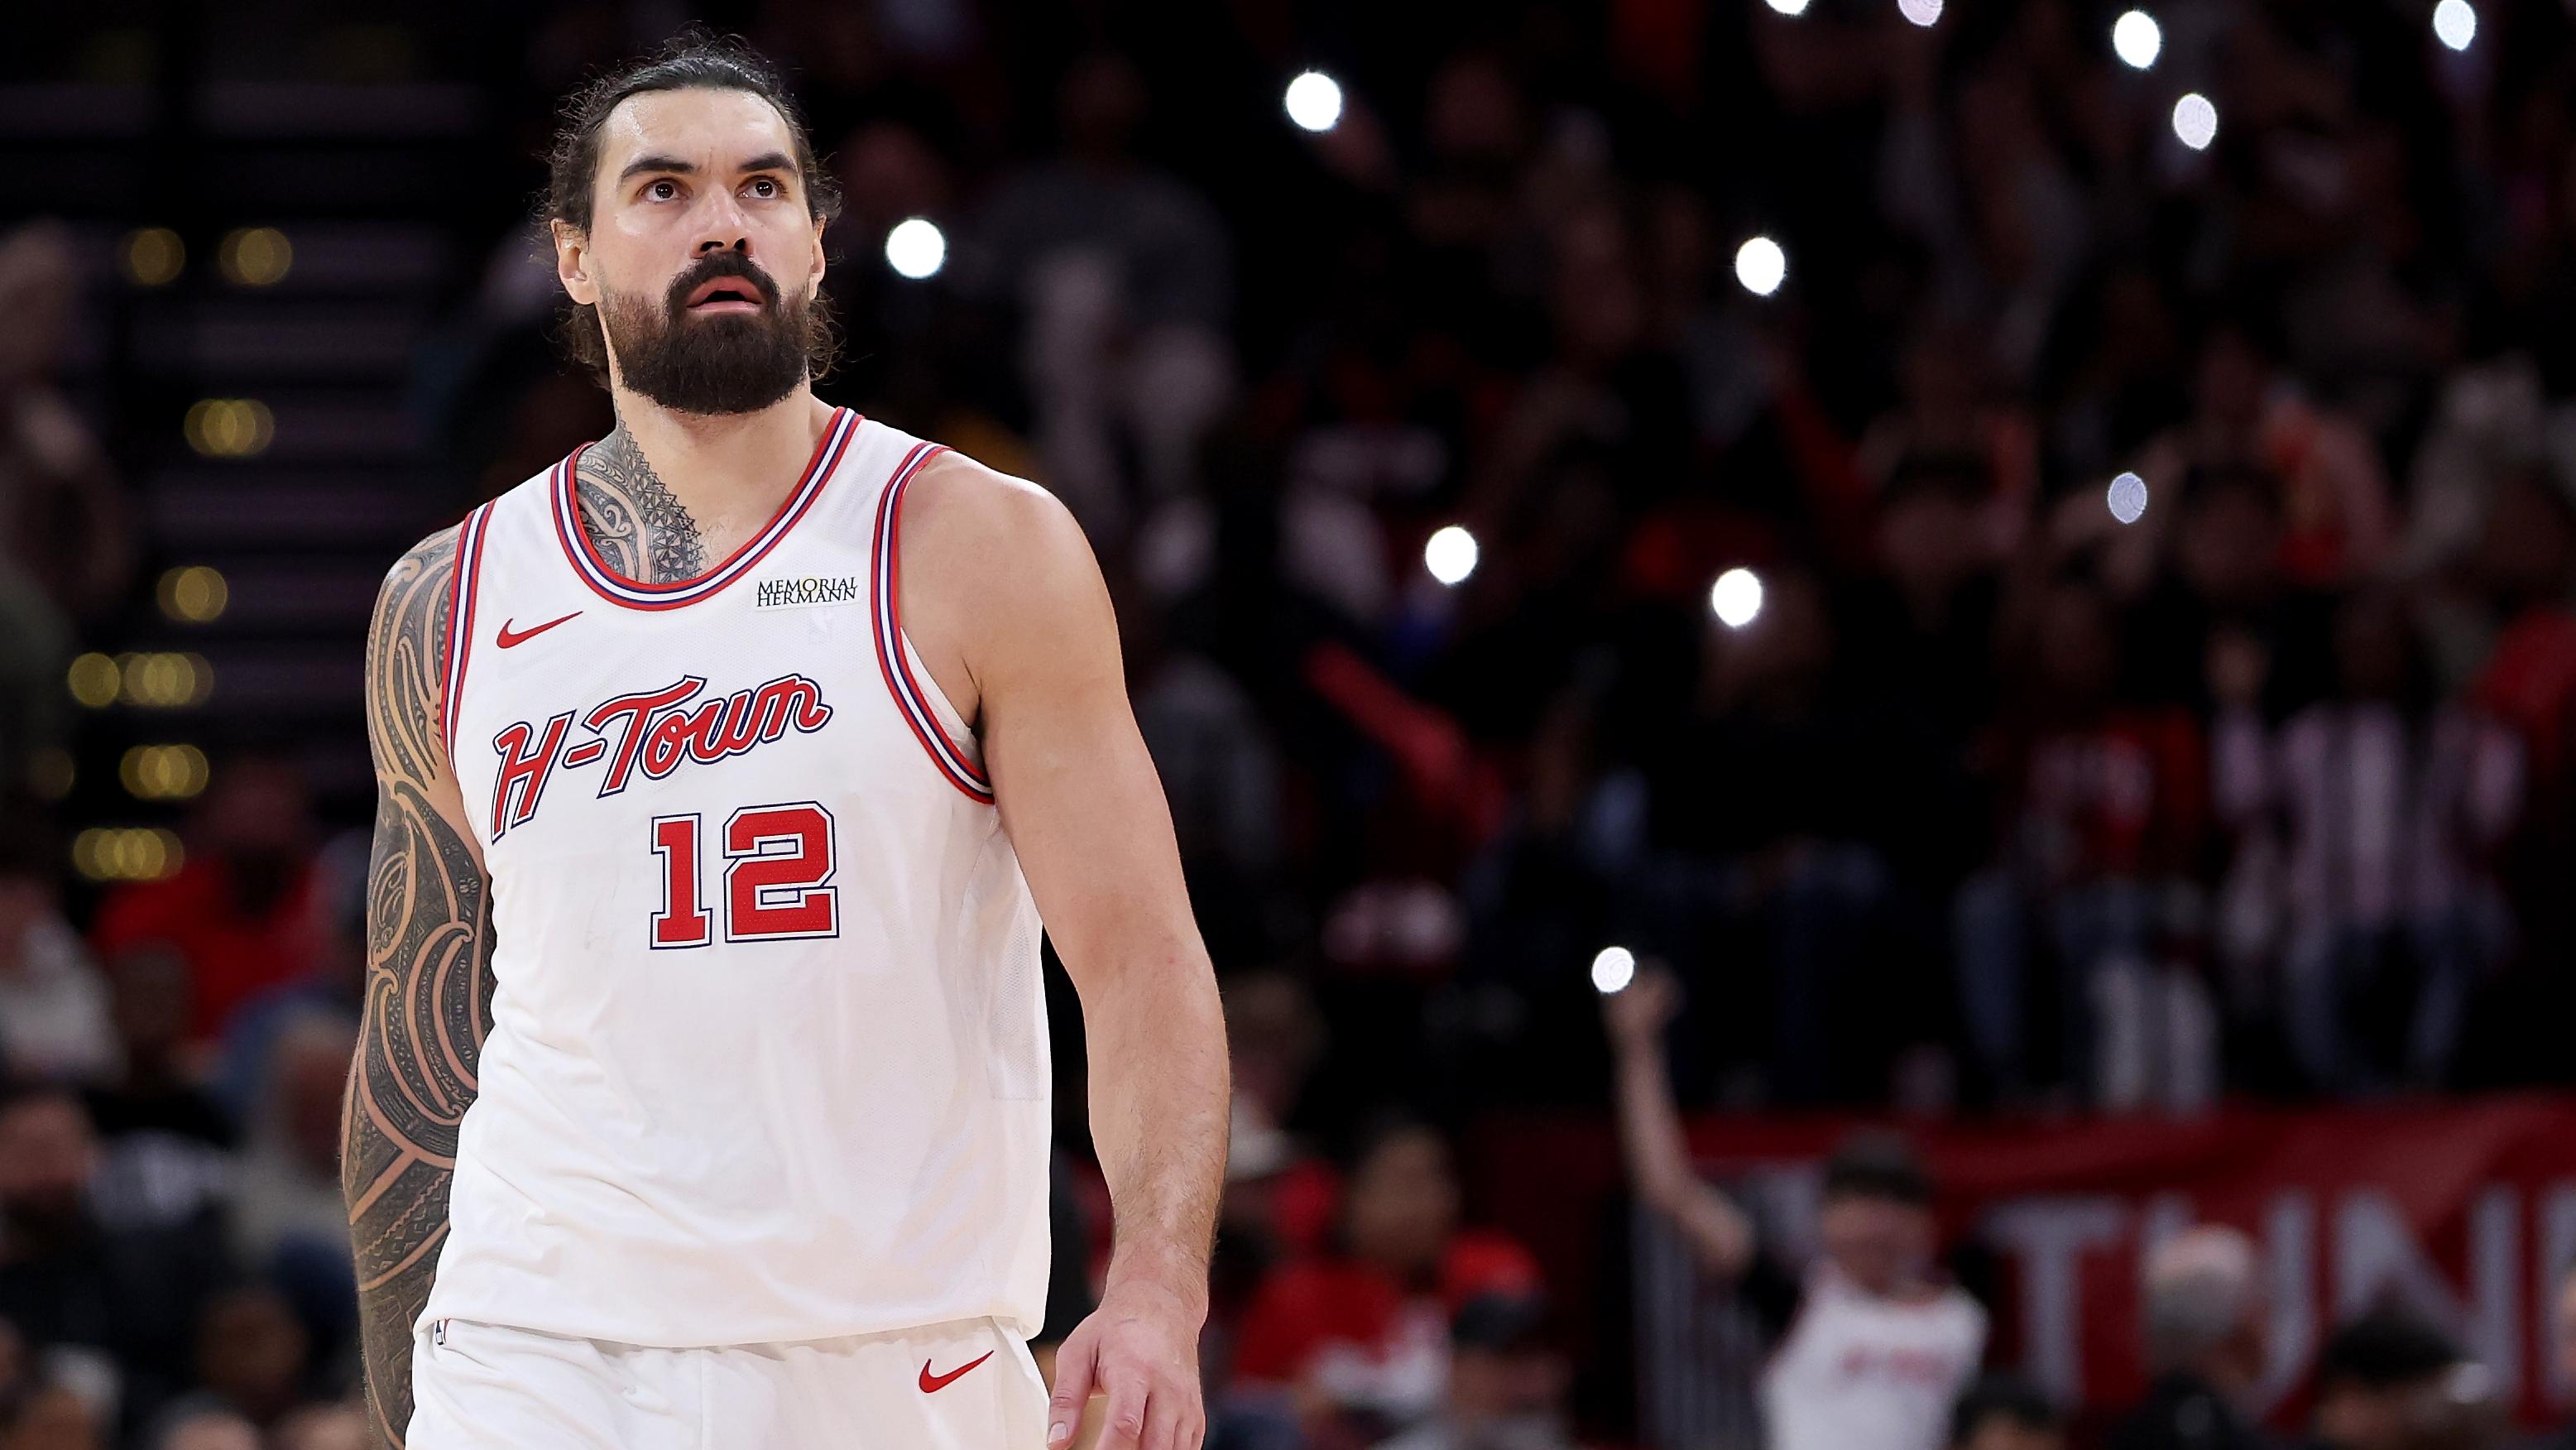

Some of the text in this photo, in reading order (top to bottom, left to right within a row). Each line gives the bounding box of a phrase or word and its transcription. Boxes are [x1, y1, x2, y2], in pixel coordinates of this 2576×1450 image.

[757, 577, 857, 594] MEMORIAL
[757, 588, 856, 607] HERMANN
[492, 673, 833, 844] H-Town
[649, 800, 840, 951] 12
